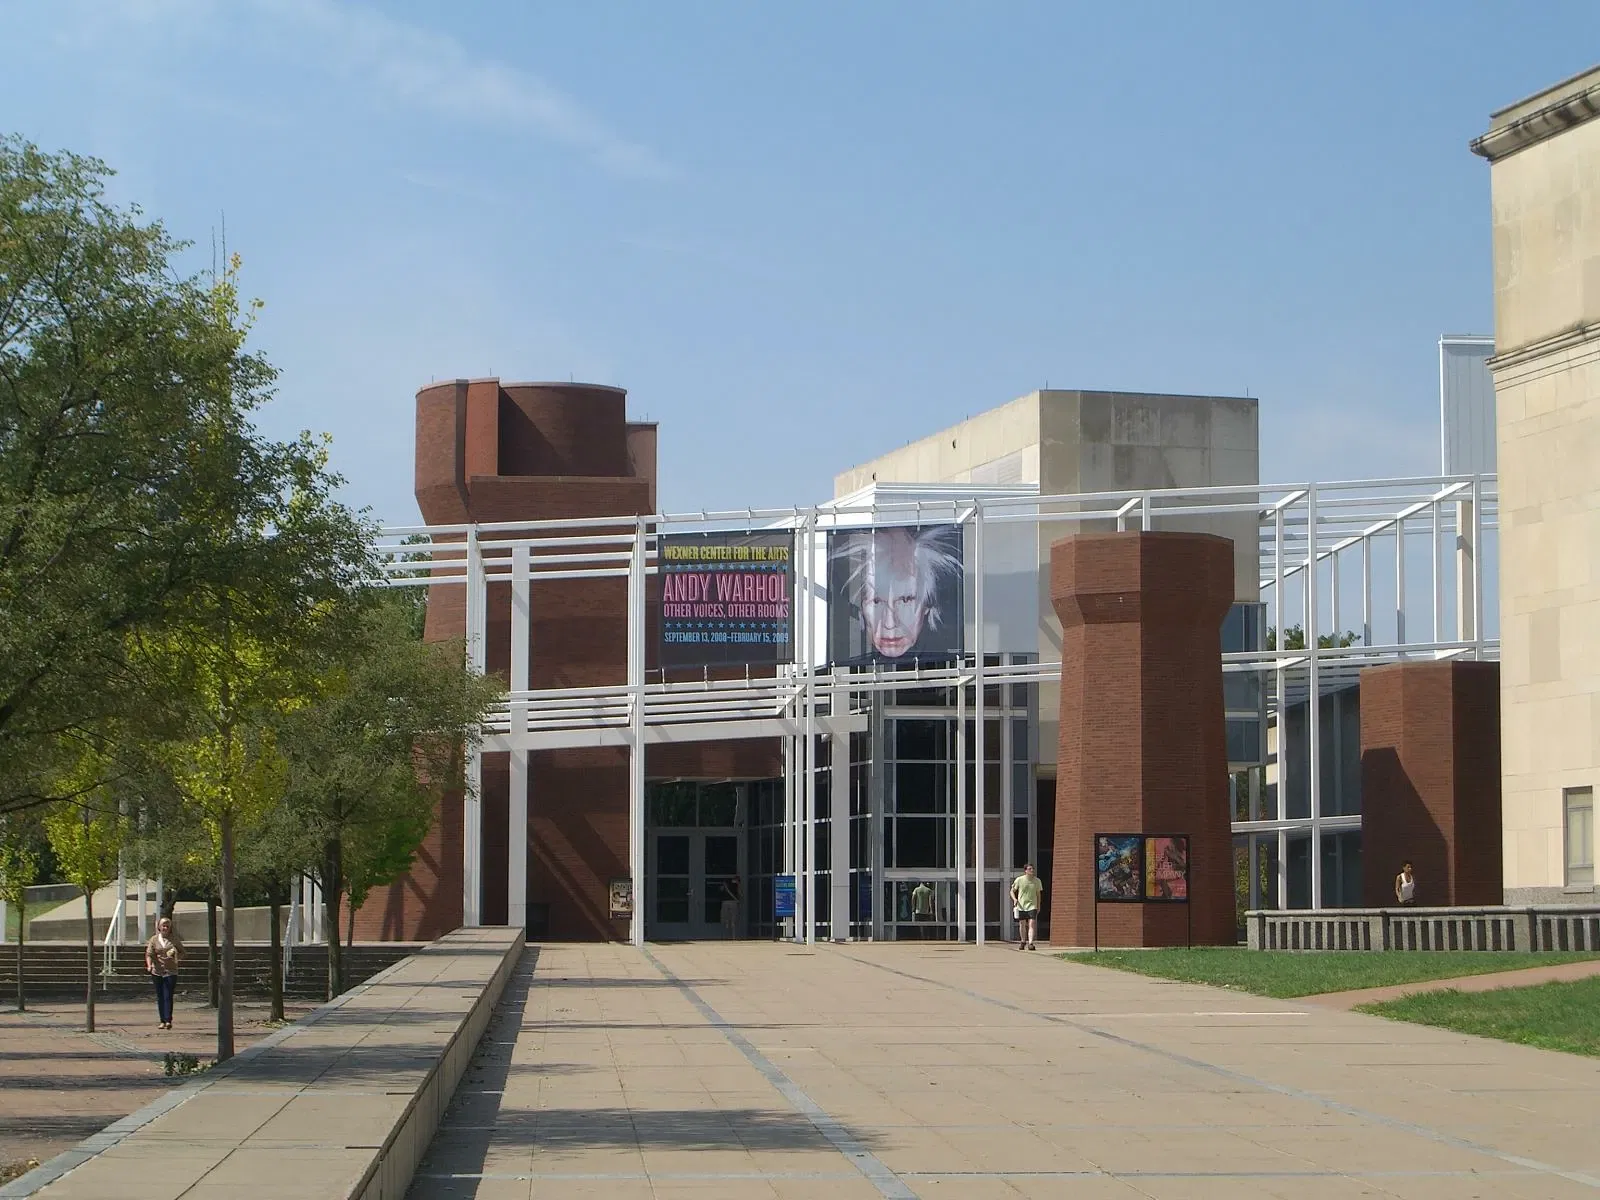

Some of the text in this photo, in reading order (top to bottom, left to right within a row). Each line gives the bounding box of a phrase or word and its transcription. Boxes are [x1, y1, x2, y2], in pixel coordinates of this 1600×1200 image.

[664, 545, 789, 560] WEXNER CENTER FOR THE ARTS
[664, 573, 790, 602] ANDY WARHOL
[663, 603, 789, 619] OTHER VOICES, OTHER ROOMS
[664, 631, 701, 643] SEPTEMBER
[772, 632, 789, 643] 2009
